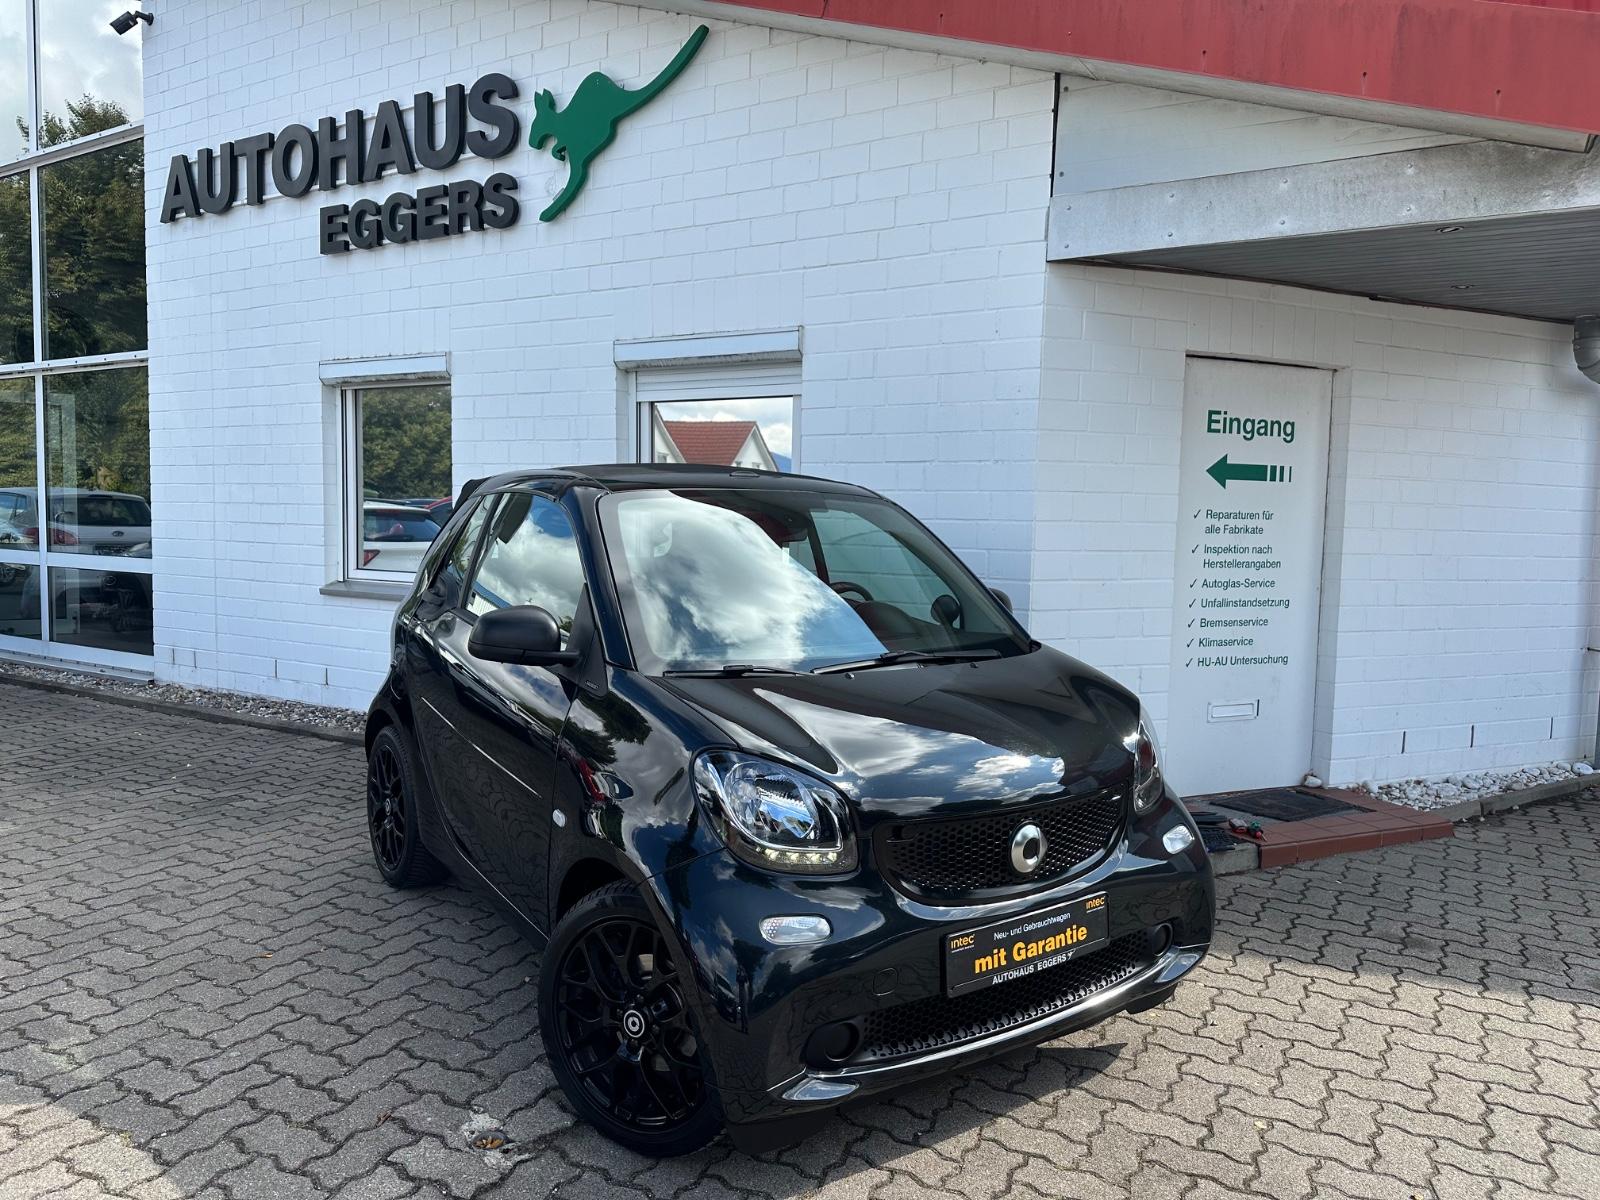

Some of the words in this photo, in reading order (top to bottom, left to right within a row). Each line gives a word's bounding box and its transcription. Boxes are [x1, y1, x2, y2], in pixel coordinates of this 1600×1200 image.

[160, 72, 519, 223] AUTOHAUS
[320, 172, 519, 255] EGGERS
[1207, 409, 1296, 444] Eingang
[1205, 509, 1260, 521] Reparaturen
[1262, 510, 1274, 520] für
[1204, 524, 1221, 534] alle
[1223, 524, 1264, 535] Fabrikate
[1203, 544, 1250, 556] Inspektion
[1252, 544, 1273, 554] nach
[1203, 559, 1281, 571] Herstellerangaben
[1201, 578, 1276, 590] Autoglas-Service
[1201, 598, 1290, 609] Unfallinstandsetzung
[1200, 617, 1269, 628] Bremsenservice
[1198, 636, 1254, 647] Klimaservice
[1197, 656, 1228, 667] HU-AU
[1230, 654, 1289, 666] Untersuchung
[993, 931, 1009, 941] Neu-
[1010, 925, 1022, 936] und
[1023, 912, 1071, 932] Gebrauchtwagen
[951, 934, 975, 949] intec
[975, 947, 1007, 974] mit
[1013, 924, 1088, 962] Garantie
[992, 965, 1035, 985] AUTOHAUS
[1037, 953, 1067, 971] EGGERS
